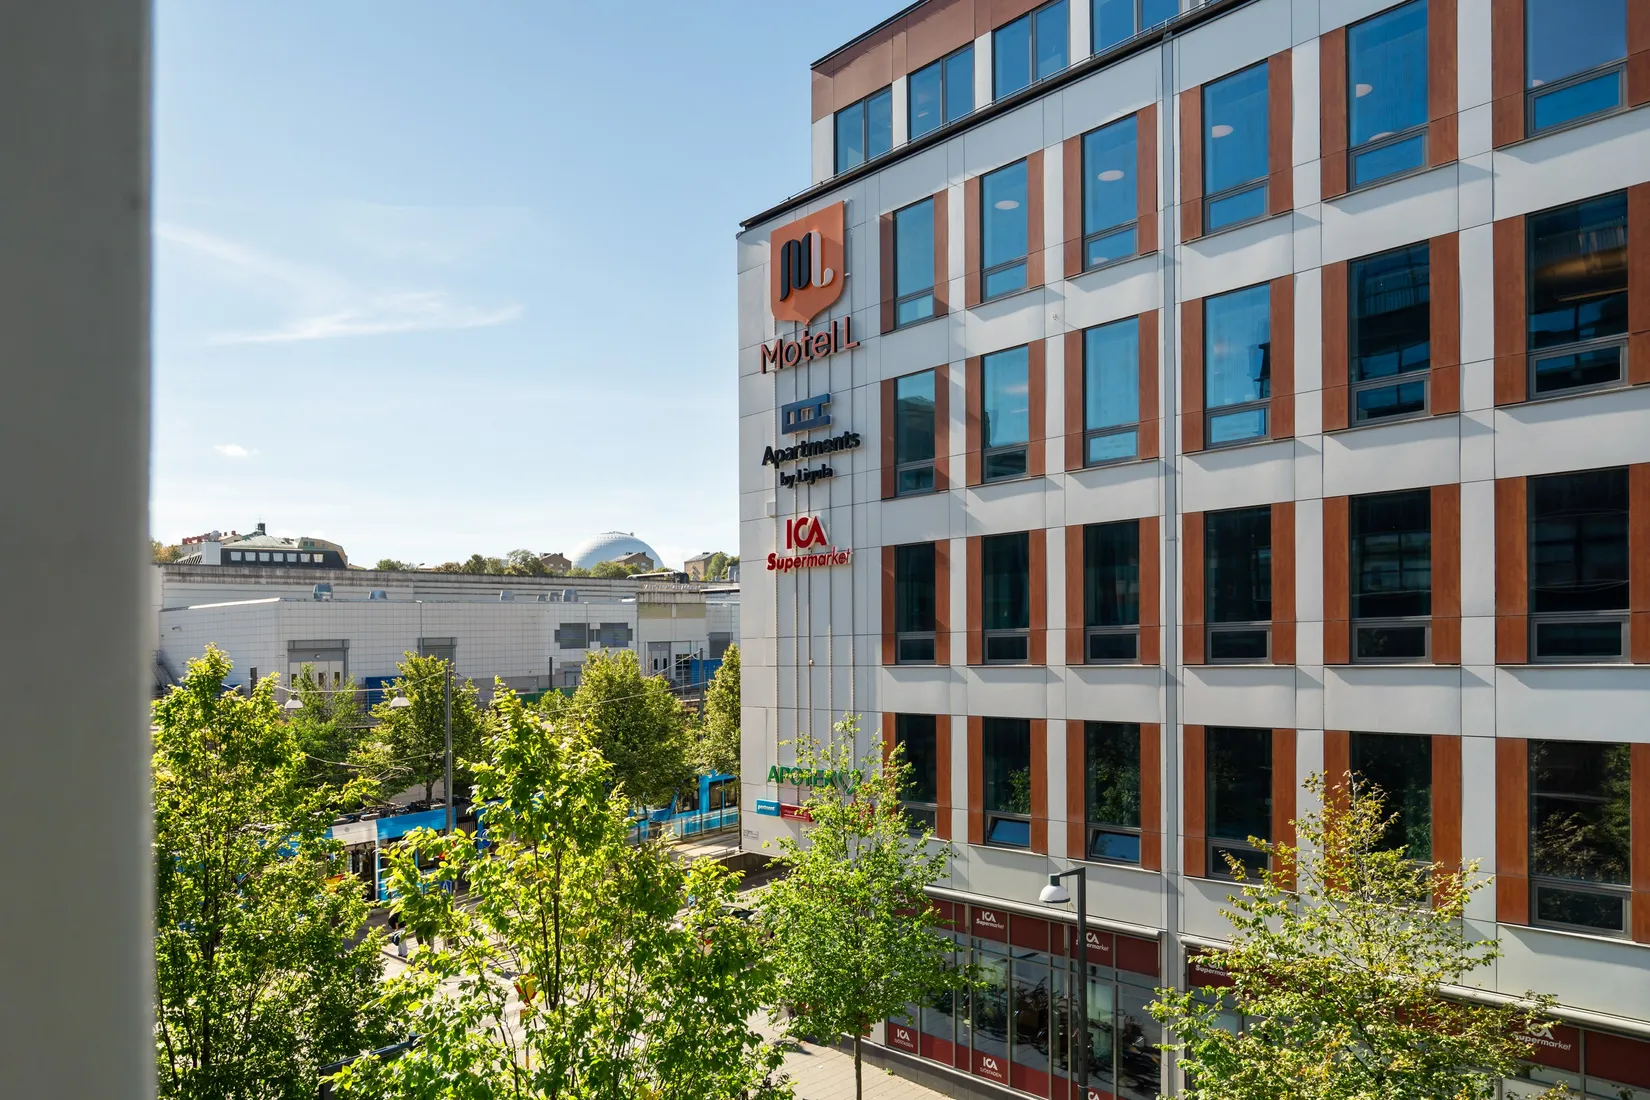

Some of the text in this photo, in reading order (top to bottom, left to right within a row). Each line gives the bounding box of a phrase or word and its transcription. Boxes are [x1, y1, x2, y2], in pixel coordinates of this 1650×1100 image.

[761, 316, 860, 374] Motel L
[762, 431, 860, 469] Apartments
[780, 463, 833, 488] by Ligula
[786, 515, 828, 549] ICA
[767, 546, 852, 573] Supermarket
[976, 918, 1004, 929] Supermarket
[981, 911, 996, 923] ICA
[1086, 932, 1099, 944] CA
[896, 1028, 910, 1041] ICA
[1516, 1034, 1572, 1051] upermarket
[983, 1056, 998, 1071] ICA
[1087, 1091, 1100, 1100] CA
